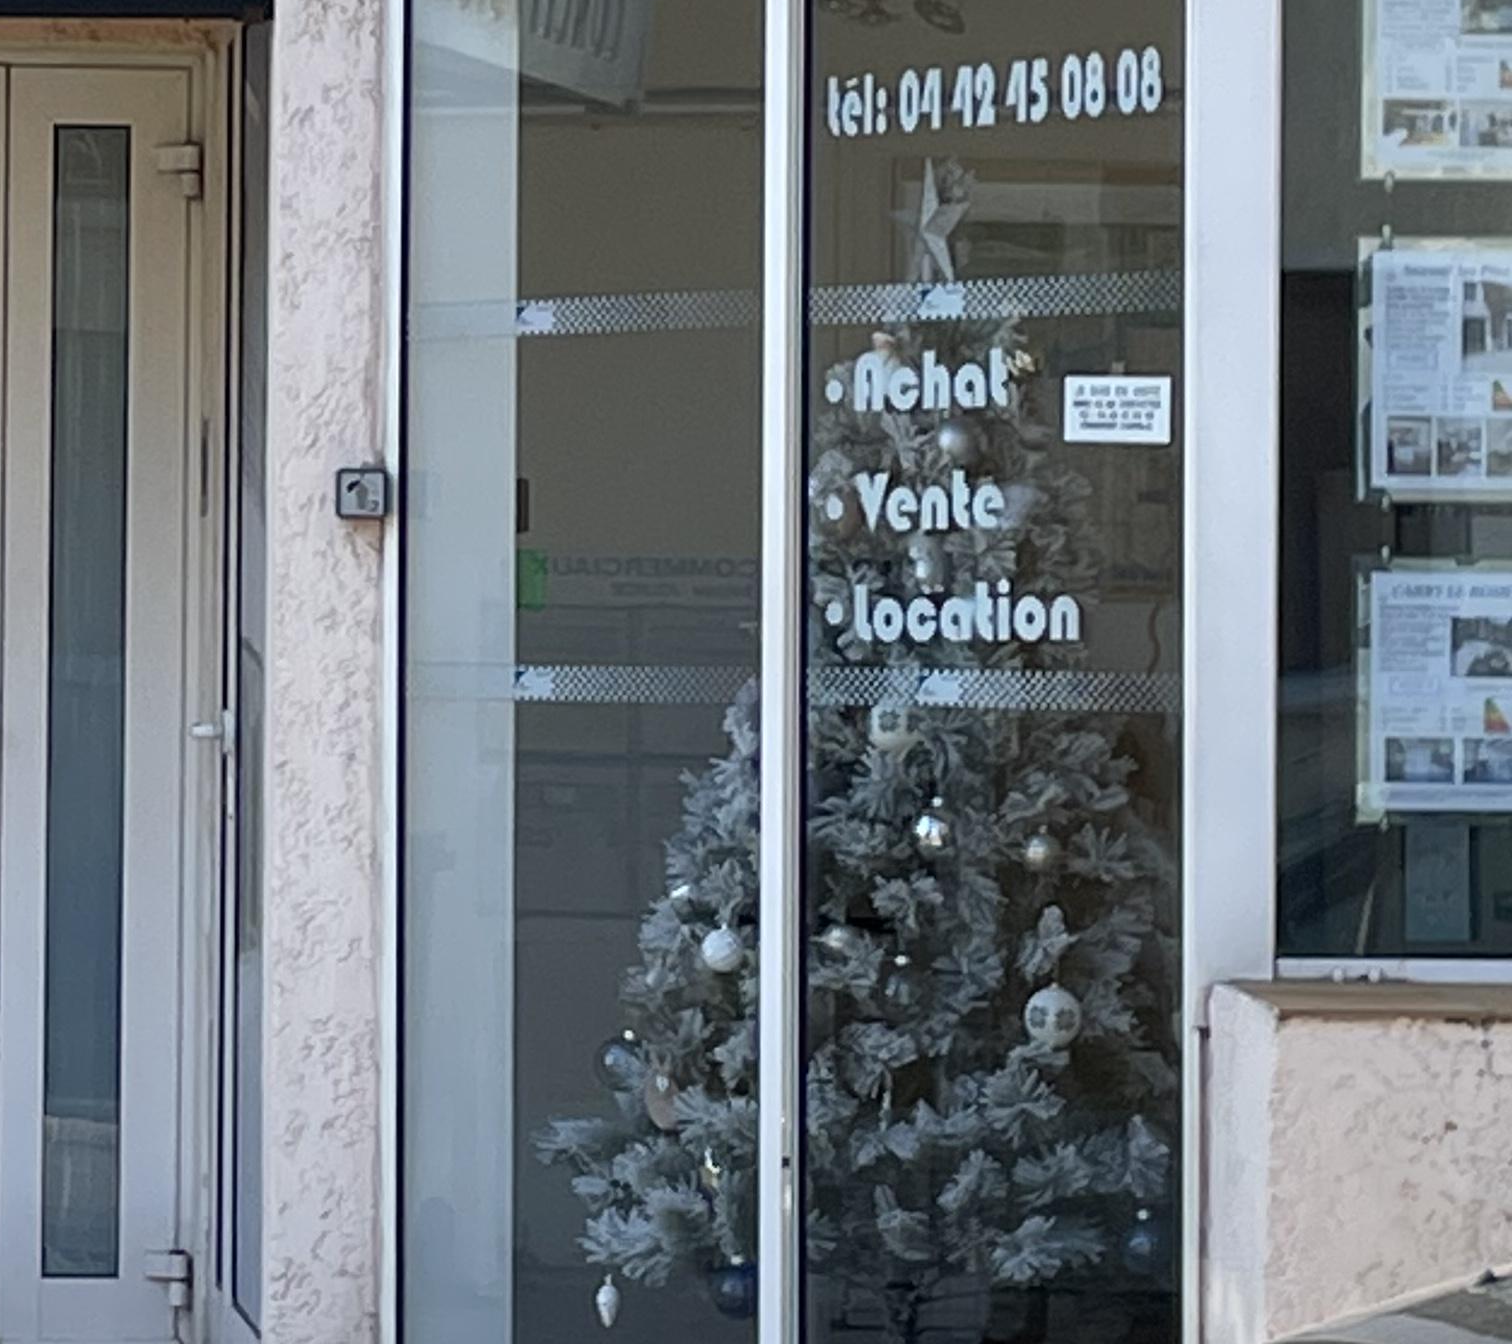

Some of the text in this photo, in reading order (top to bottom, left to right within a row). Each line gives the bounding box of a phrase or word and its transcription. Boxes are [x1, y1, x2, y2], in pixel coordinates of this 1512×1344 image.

[826, 45, 1163, 137] tél: 04 42 45 08 08
[853, 347, 1009, 411] Achat
[853, 468, 1006, 534] Vente
[853, 577, 1081, 643] Location
